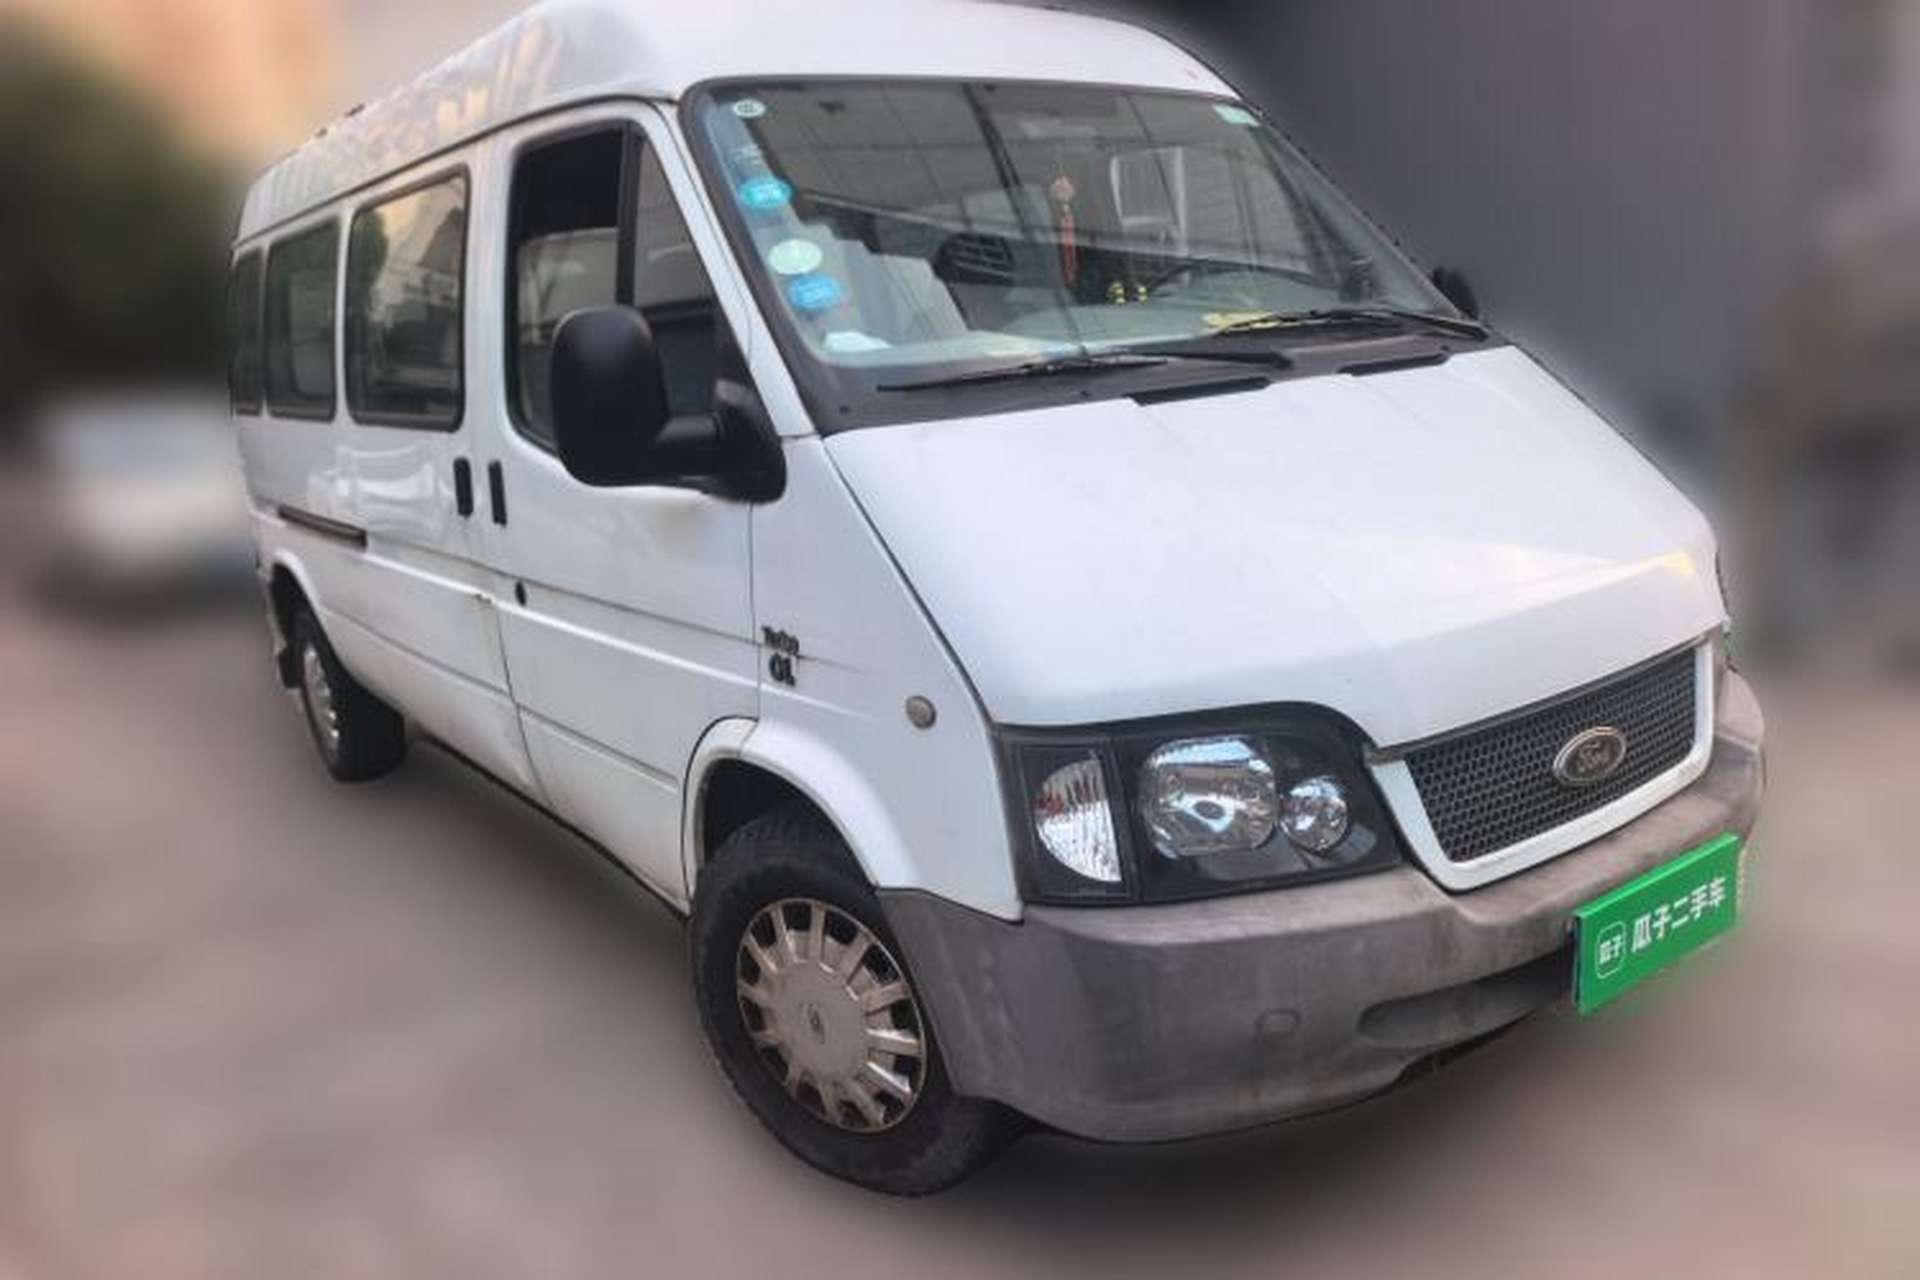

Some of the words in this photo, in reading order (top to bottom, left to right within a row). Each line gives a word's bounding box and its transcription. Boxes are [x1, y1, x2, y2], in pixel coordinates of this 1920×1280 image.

[1631, 876, 1727, 953] 瓜子二手车
